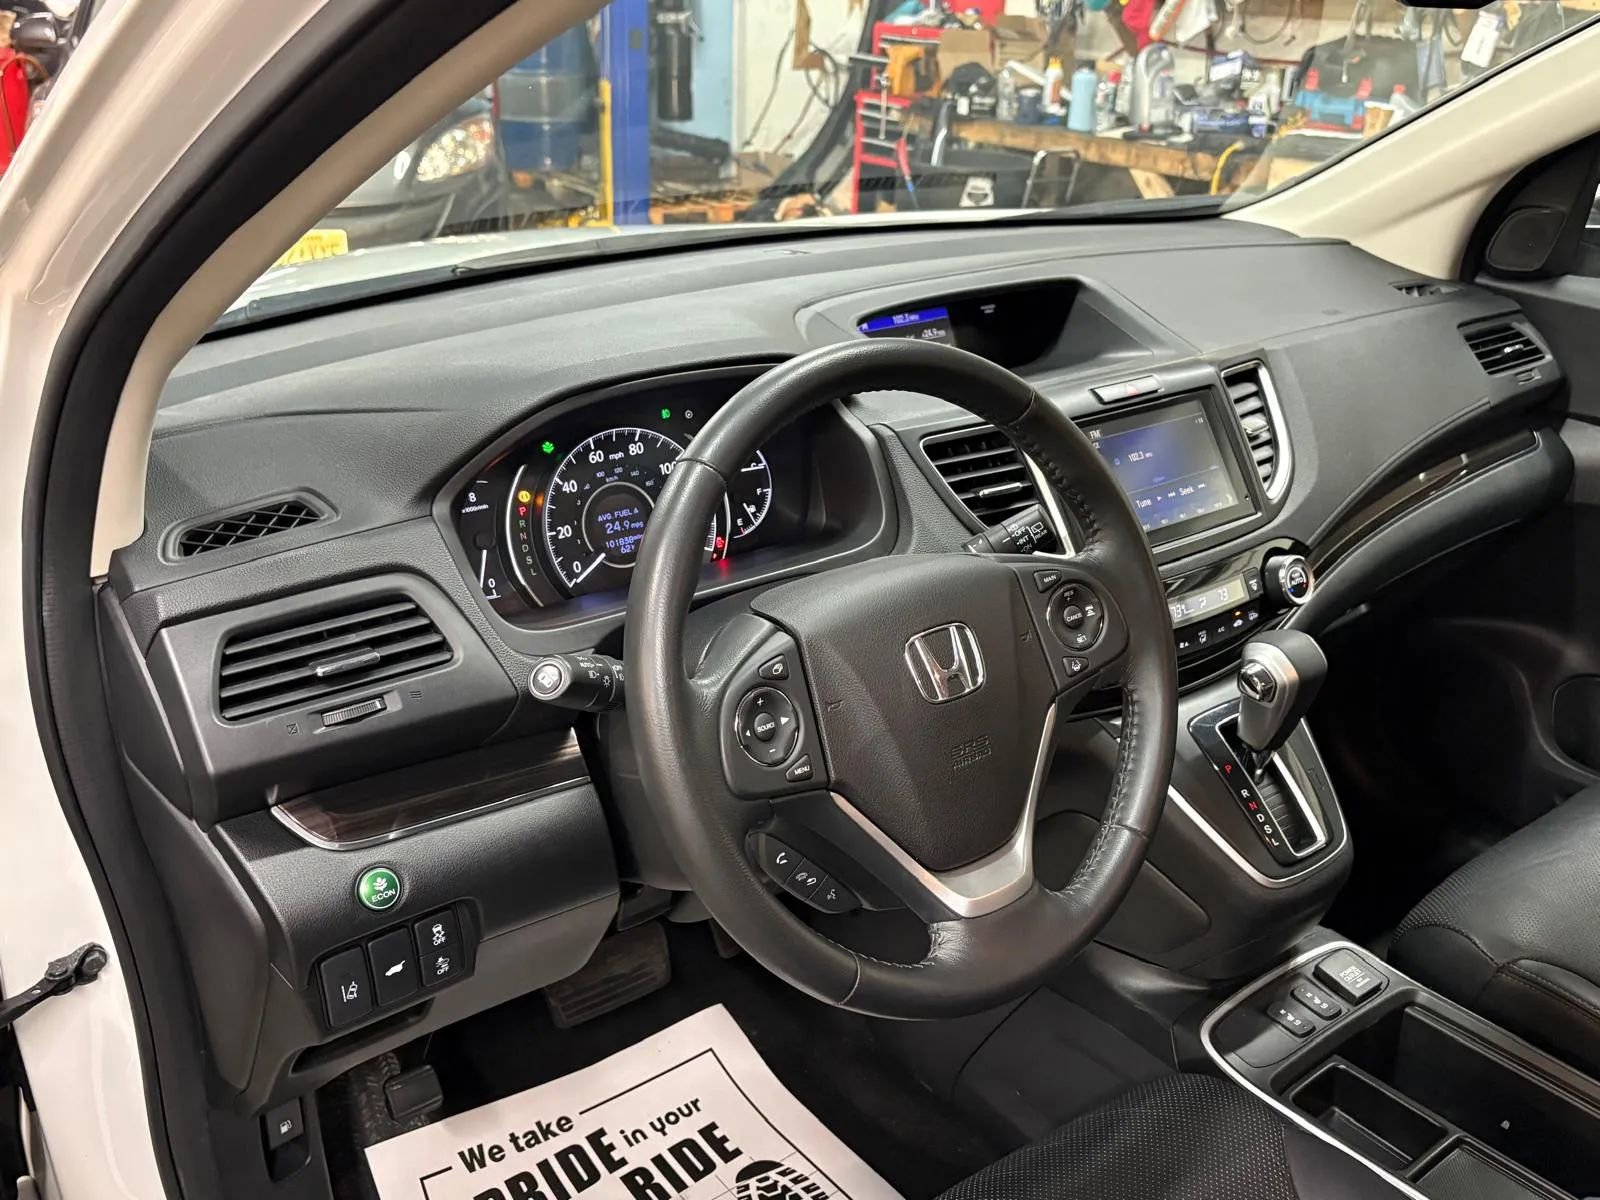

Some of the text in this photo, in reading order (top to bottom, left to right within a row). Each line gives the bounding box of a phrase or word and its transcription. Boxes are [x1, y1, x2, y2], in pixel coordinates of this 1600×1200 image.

[628, 442, 644, 455] 80
[589, 450, 604, 463] 60
[609, 451, 624, 460] mph
[562, 480, 578, 493] 40
[468, 492, 476, 502] 8
[519, 506, 526, 516] P
[596, 513, 611, 522] AVG
[614, 508, 632, 518] FUEL
[557, 525, 572, 539] 20
[605, 520, 630, 534] 24.9
[573, 561, 581, 573] 0
[488, 578, 496, 588] 0
[757, 722, 775, 733] SOURCE
[794, 766, 810, 775] MENU
[1225, 764, 1279, 847] P R N D S L
[371, 888, 396, 903] ECON
[433, 937, 446, 945] OFF
[437, 966, 450, 975] OFF
[457, 1115, 575, 1174] We take
[473, 1098, 702, 1200] RIDE in your
[619, 1121, 744, 1200] RIDE
